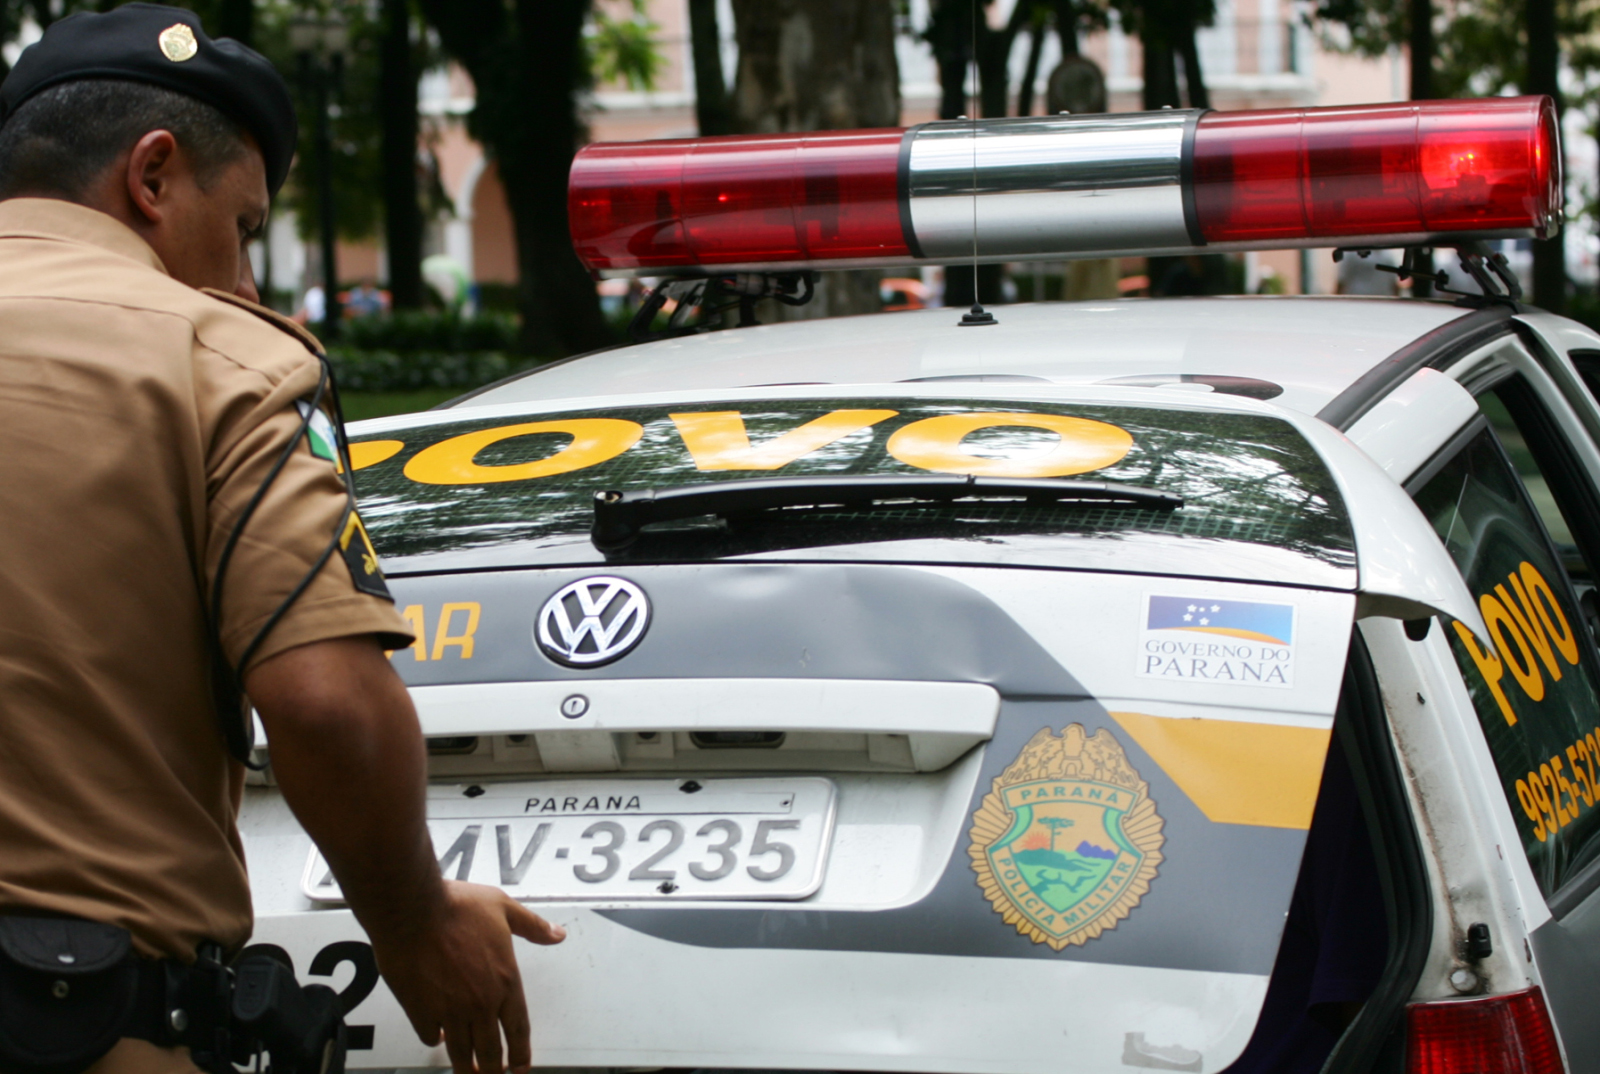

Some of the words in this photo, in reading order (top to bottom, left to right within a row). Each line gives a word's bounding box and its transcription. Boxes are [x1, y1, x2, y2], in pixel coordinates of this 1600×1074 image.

[1145, 639, 1252, 660] GOVERNO
[1260, 647, 1290, 662] DO
[1452, 561, 1579, 726] POVO
[1143, 655, 1289, 684] PARANÁ
[524, 796, 640, 813] PARANA
[1062, 860, 1133, 926] MILITAR
